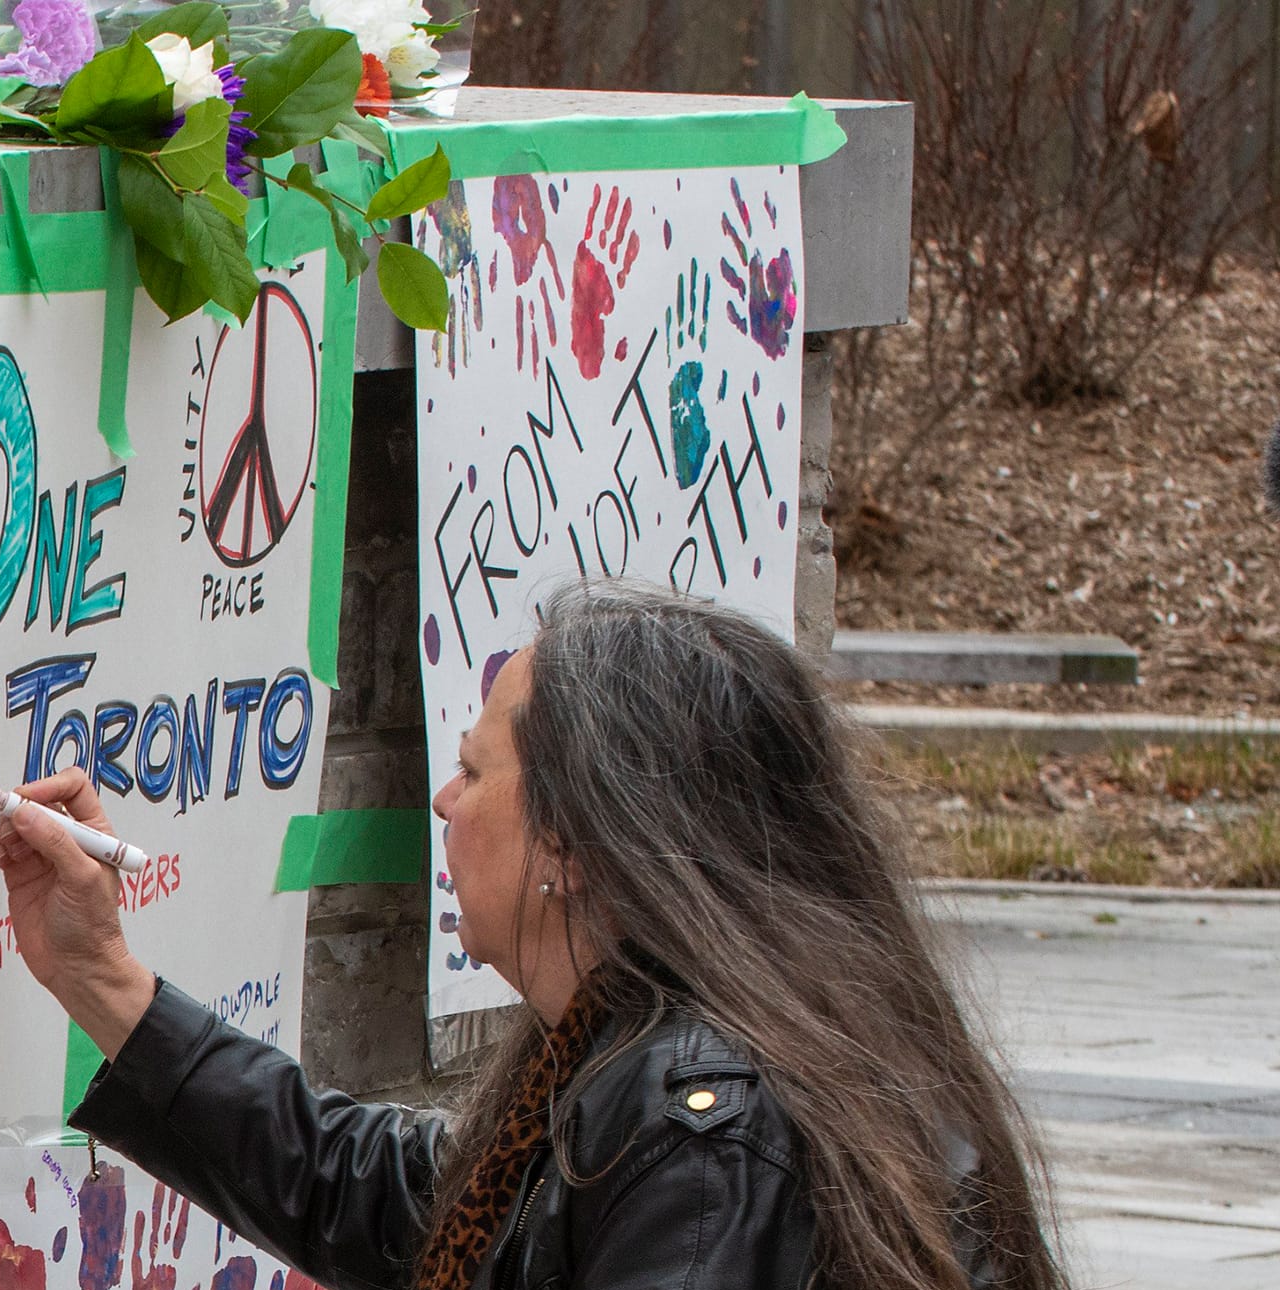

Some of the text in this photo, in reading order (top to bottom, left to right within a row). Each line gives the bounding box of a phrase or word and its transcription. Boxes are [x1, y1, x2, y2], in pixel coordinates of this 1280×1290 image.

[179, 335, 208, 544] UNITY
[435, 357, 583, 668] FROM
[200, 572, 266, 621] PEACE
[6, 652, 313, 817] TORONTO
[117, 853, 181, 913] AYERS
